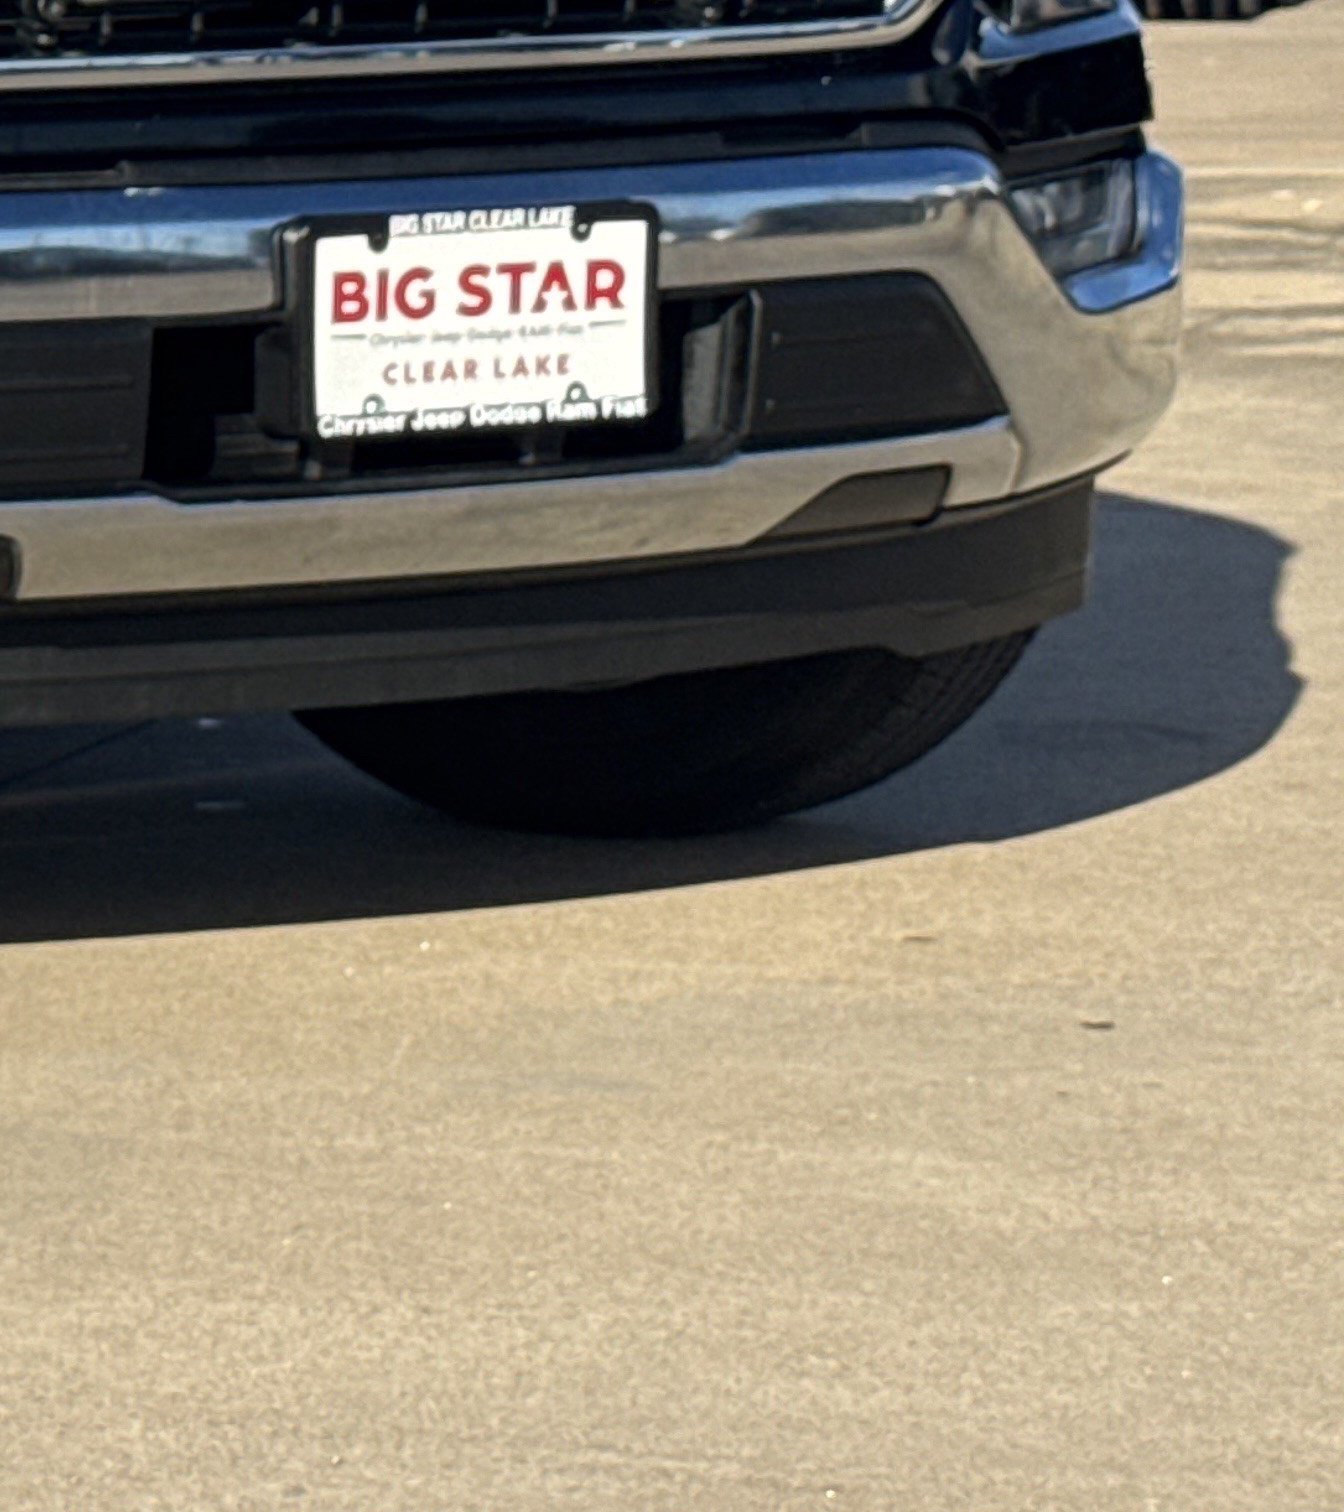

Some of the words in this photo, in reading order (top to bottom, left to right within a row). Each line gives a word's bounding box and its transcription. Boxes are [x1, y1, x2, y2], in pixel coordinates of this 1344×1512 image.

[331, 266, 436, 324] BIG
[456, 258, 627, 317] STAR
[382, 354, 480, 386] CLEAR
[493, 352, 572, 379] LAKE
